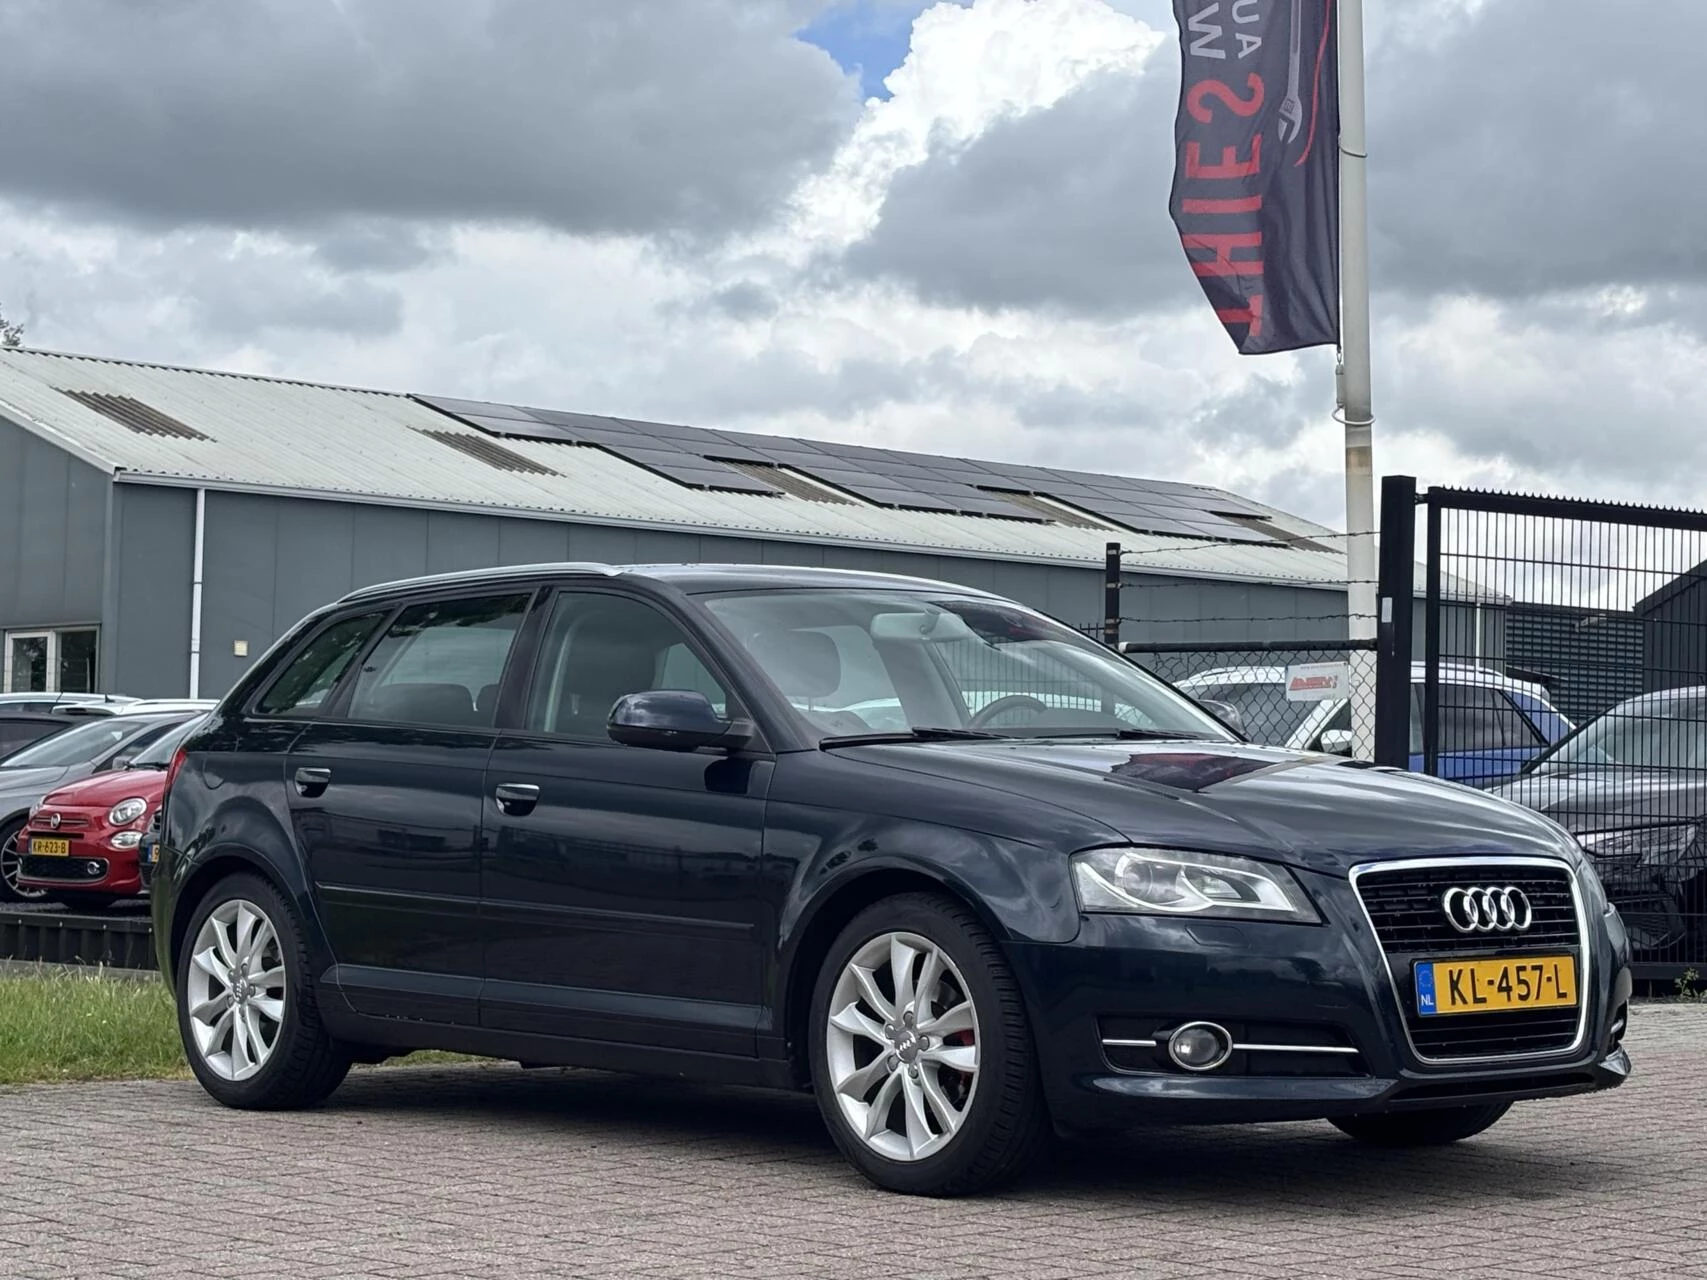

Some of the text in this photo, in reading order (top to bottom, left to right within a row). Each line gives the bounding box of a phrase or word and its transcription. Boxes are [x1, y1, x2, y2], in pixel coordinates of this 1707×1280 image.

[33, 840, 66, 854] KR-623-B
[1448, 963, 1568, 1005] KL-457-L
[1420, 994, 1434, 1006] NL
